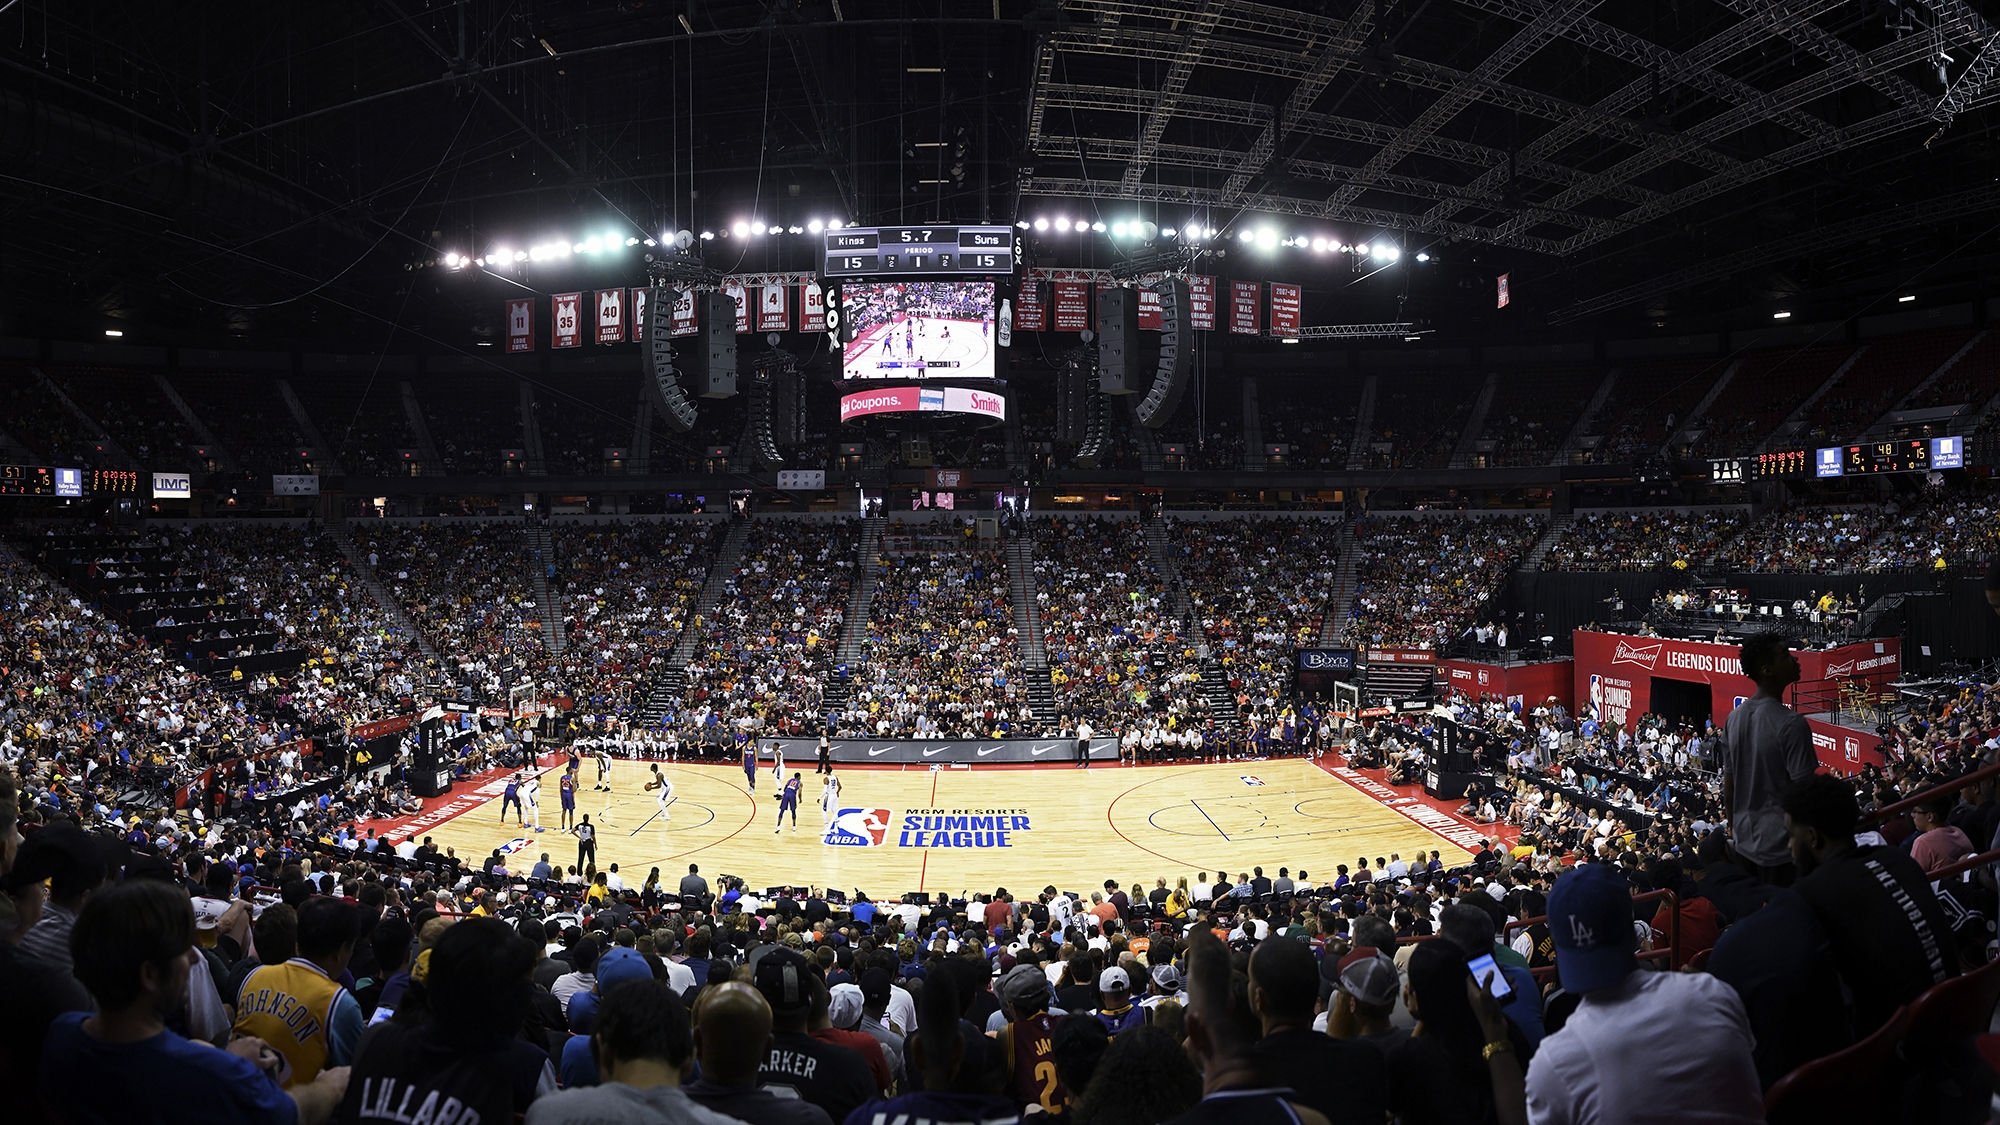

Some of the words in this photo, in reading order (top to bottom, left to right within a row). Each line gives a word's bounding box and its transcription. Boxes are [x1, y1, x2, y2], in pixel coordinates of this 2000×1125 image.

[838, 237, 865, 245] Kings
[901, 231, 932, 242] 5.7
[974, 234, 999, 245] Suns
[1014, 237, 1022, 264] COX
[844, 257, 862, 268] 15
[915, 256, 920, 267] 1
[942, 259, 948, 267] 2
[977, 255, 995, 266] 15
[769, 293, 777, 305] 4
[809, 294, 823, 306] 50
[602, 306, 617, 318] 40
[1193, 302, 1207, 311] WAC
[1239, 305, 1252, 313] WAC
[515, 317, 524, 328] 11
[560, 317, 573, 329] 35
[826, 289, 840, 352] COX
[851, 395, 901, 409] Coupons.
[971, 393, 1001, 414] Smith's
[1878, 443, 1892, 455] 48
[1917, 448, 1925, 459] 15
[1759, 455, 1767, 463] 30
[1768, 454, 1776, 462] 34
[1787, 452, 1795, 460] 40
[1796, 451, 1804, 459] 42
[1852, 454, 1860, 464] 15
[6, 467, 20, 478] 57
[95, 470, 99, 478] 2
[103, 470, 108, 479] 10
[110, 471, 118, 479] 20
[120, 471, 127, 480] 25
[128, 472, 136, 480] 45
[42, 475, 50, 486] 15
[154, 478, 189, 491] UMC
[1309, 654, 1349, 665] BOYD
[1617, 647, 1657, 661] Budweiser
[1667, 651, 1713, 672] LEGENDS
[1715, 657, 1747, 676] LOUN
[1856, 658, 1878, 671] LEGENDS
[1879, 654, 1897, 667] LOUNGE
[1452, 669, 1472, 680] ESPN
[1614, 679, 1631, 688] RESORTS
[1604, 686, 1631, 709] SUMMER
[1605, 704, 1627, 725] LEAGUE
[1851, 742, 1858, 758] TV
[561, 779, 569, 787] 25
[1353, 777, 1398, 798] RESORTS
[411, 801, 473, 825] RESORTS
[902, 816, 1031, 831] SUMMER
[829, 836, 860, 845] NBA
[899, 831, 1013, 848] LEAGUE
[1864, 860, 1897, 889] NIKE
[1062, 906, 1070, 918] 2
[1568, 914, 1596, 946] LA
[238, 989, 320, 1045] JOHNSON
[1034, 1061, 1067, 1115] 2
